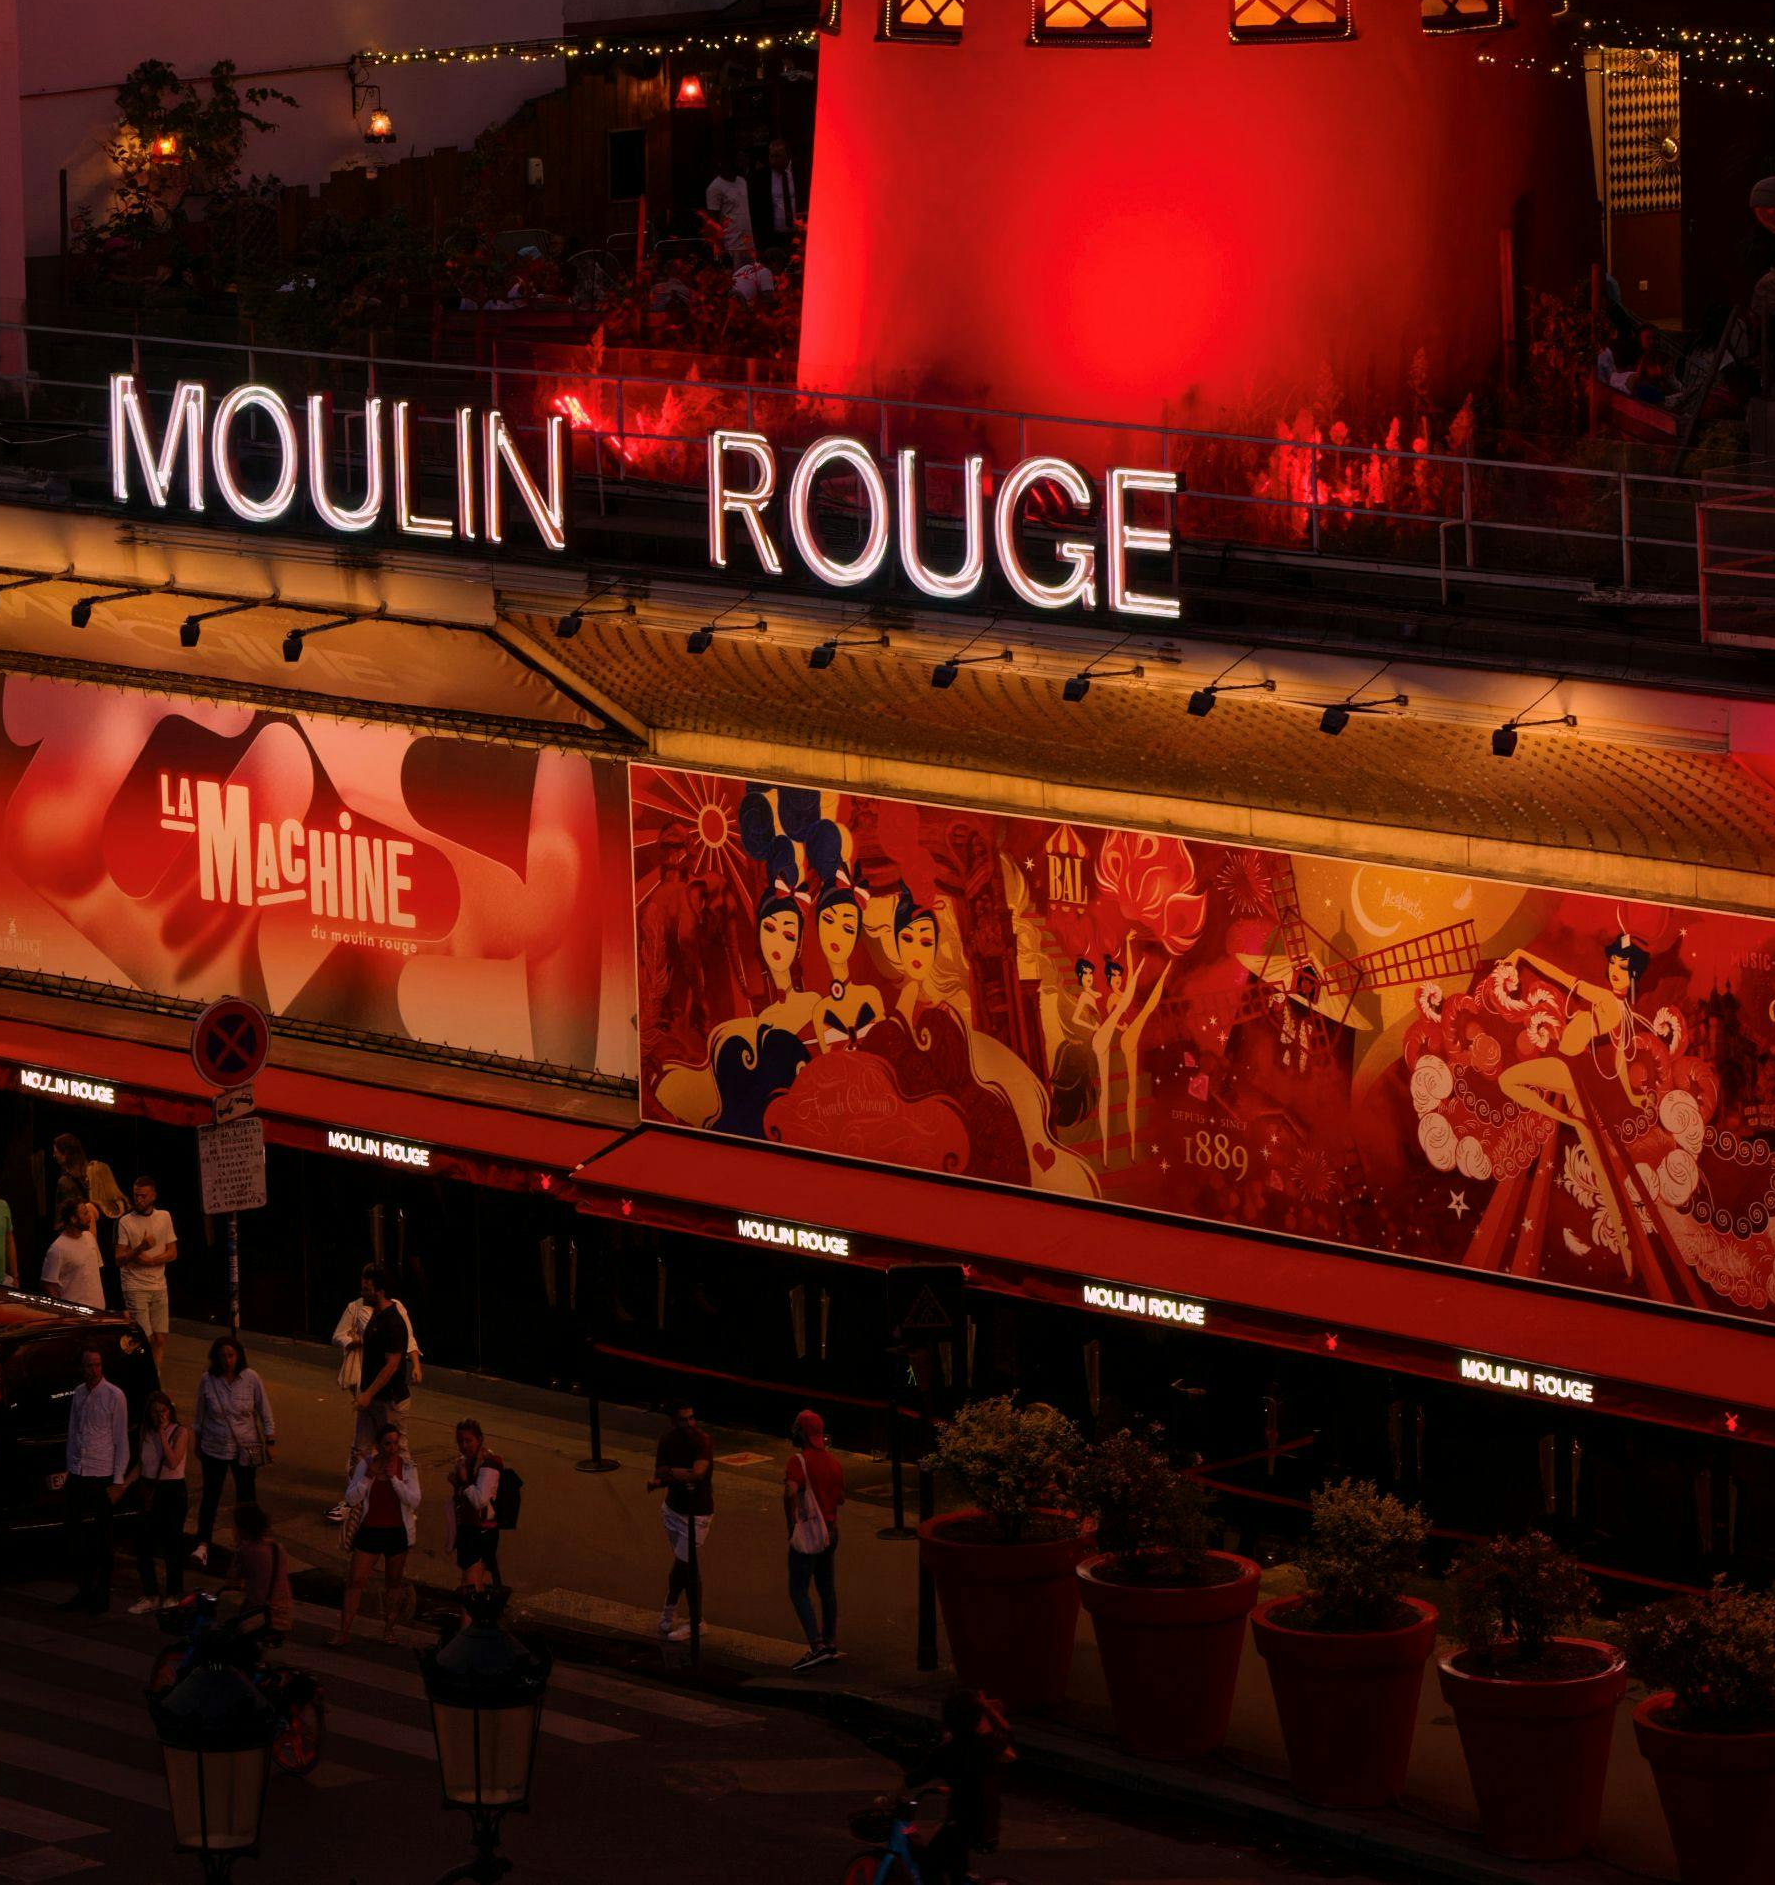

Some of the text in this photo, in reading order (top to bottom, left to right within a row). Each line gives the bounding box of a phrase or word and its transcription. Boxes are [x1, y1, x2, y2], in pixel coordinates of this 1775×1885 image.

[110, 374, 1183, 618] MOULIN ROUGE
[160, 773, 195, 819] LA
[1047, 855, 1088, 904] BAL
[310, 924, 418, 956] du moulin rouge
[71, 1080, 115, 1105] ROUGE
[328, 1131, 430, 1167] MOULIN ROUGE
[1183, 1130, 1249, 1182] 1889
[737, 1219, 849, 1256] MOULIN ROUGE
[1083, 1285, 1205, 1326] MOULIN ROUGE
[1461, 1358, 1594, 1403] MOULIN ROUGE
